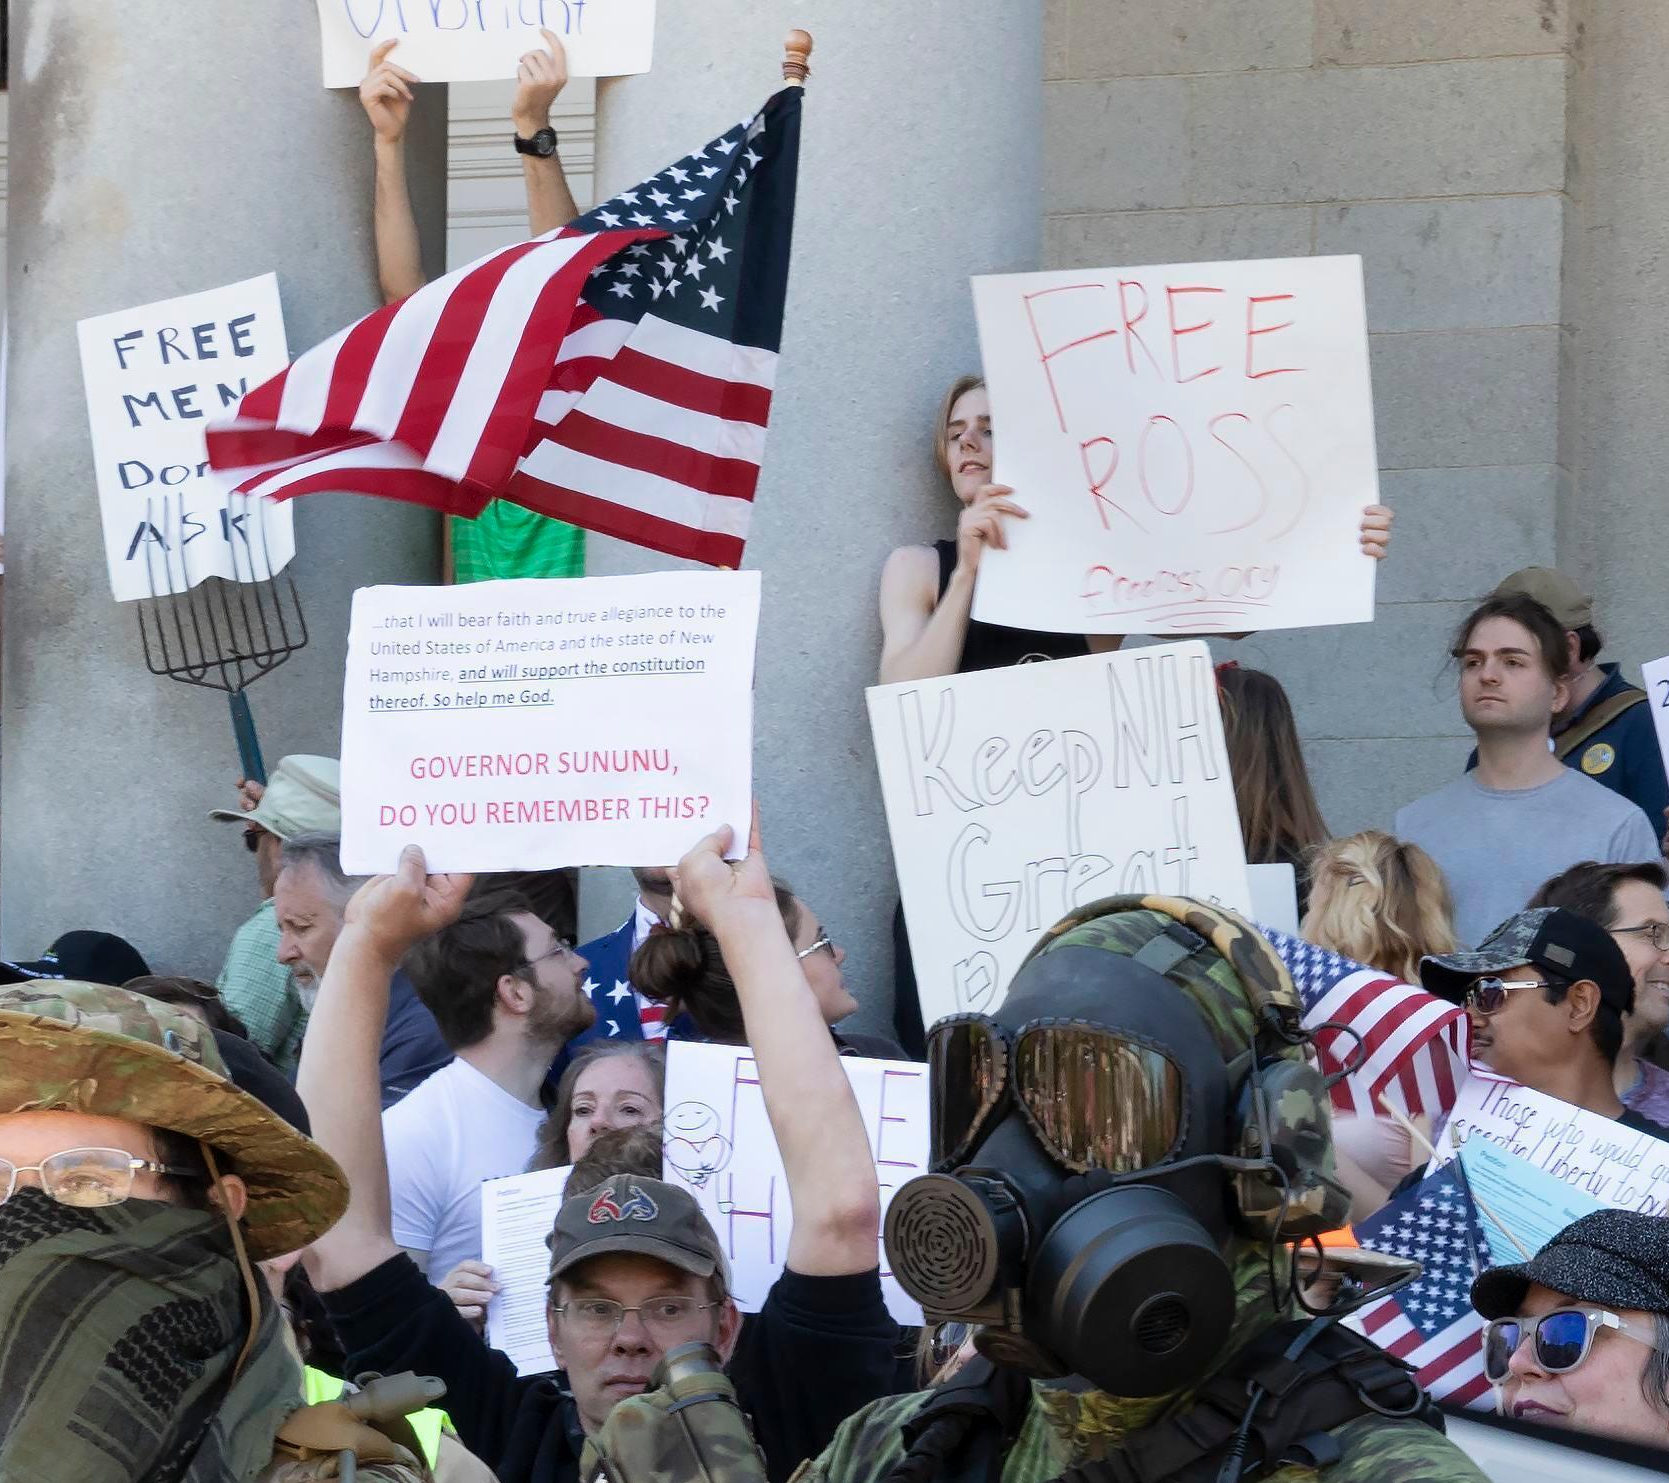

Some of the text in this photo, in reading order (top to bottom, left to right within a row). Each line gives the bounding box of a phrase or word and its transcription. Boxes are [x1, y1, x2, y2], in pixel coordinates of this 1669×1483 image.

[113, 314, 256, 369] FREE
[1023, 279, 1306, 433] FREE
[123, 378, 247, 427] MEN
[1079, 403, 1309, 542] ROSS
[126, 508, 251, 560] ASK
[427, 612, 454, 627] will
[458, 611, 493, 627] bear
[496, 610, 530, 626] faith
[536, 609, 562, 625] and
[568, 609, 597, 624] true
[601, 605, 673, 624] allegiance
[679, 606, 695, 619] to
[700, 605, 726, 619] the
[370, 630, 714, 656] United States of America and the state of New
[370, 656, 705, 685] Hampshire, and will support the constitution
[369, 689, 554, 710] thereof. So help me God.
[410, 748, 679, 779] GOVERNOR SUNUNU,
[898, 654, 1219, 856] Keep NH
[379, 795, 710, 827] DO YOU REMEMBER THIS?
[947, 796, 1198, 942] Great
[1480, 1083, 1657, 1170] Those who would
[1542, 1142, 1612, 1198] liberty
